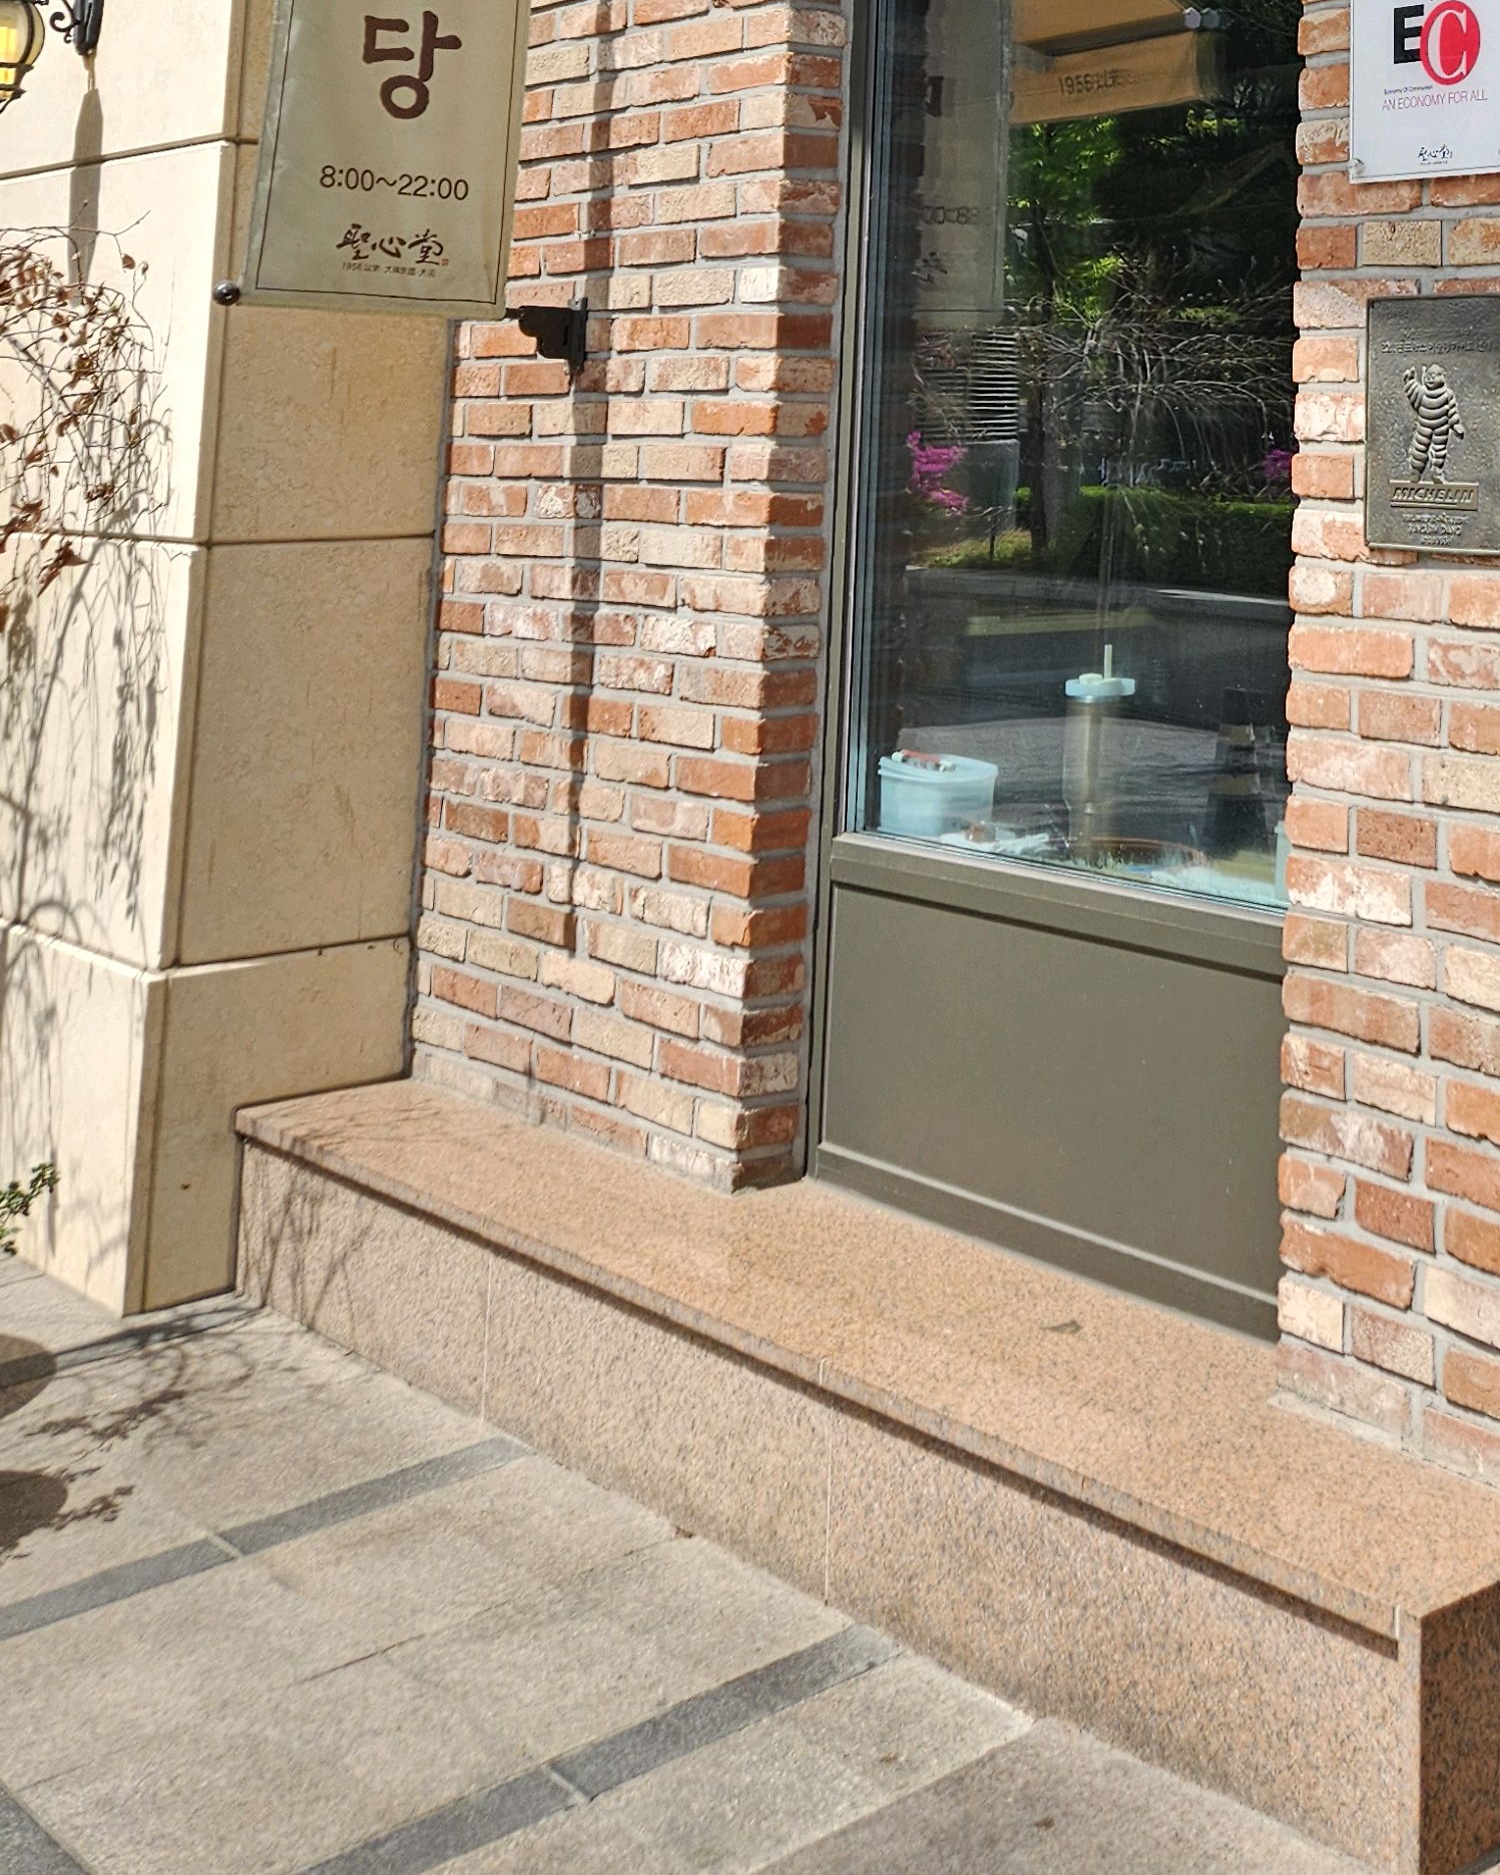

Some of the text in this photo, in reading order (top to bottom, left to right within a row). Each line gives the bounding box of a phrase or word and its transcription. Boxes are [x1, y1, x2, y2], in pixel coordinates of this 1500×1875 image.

[1382, 89, 1488, 110] AN ECONOMY FOR ALL
[319, 165, 469, 201] 8:00~22:00
[1393, 487, 1474, 503] MICHELIN
